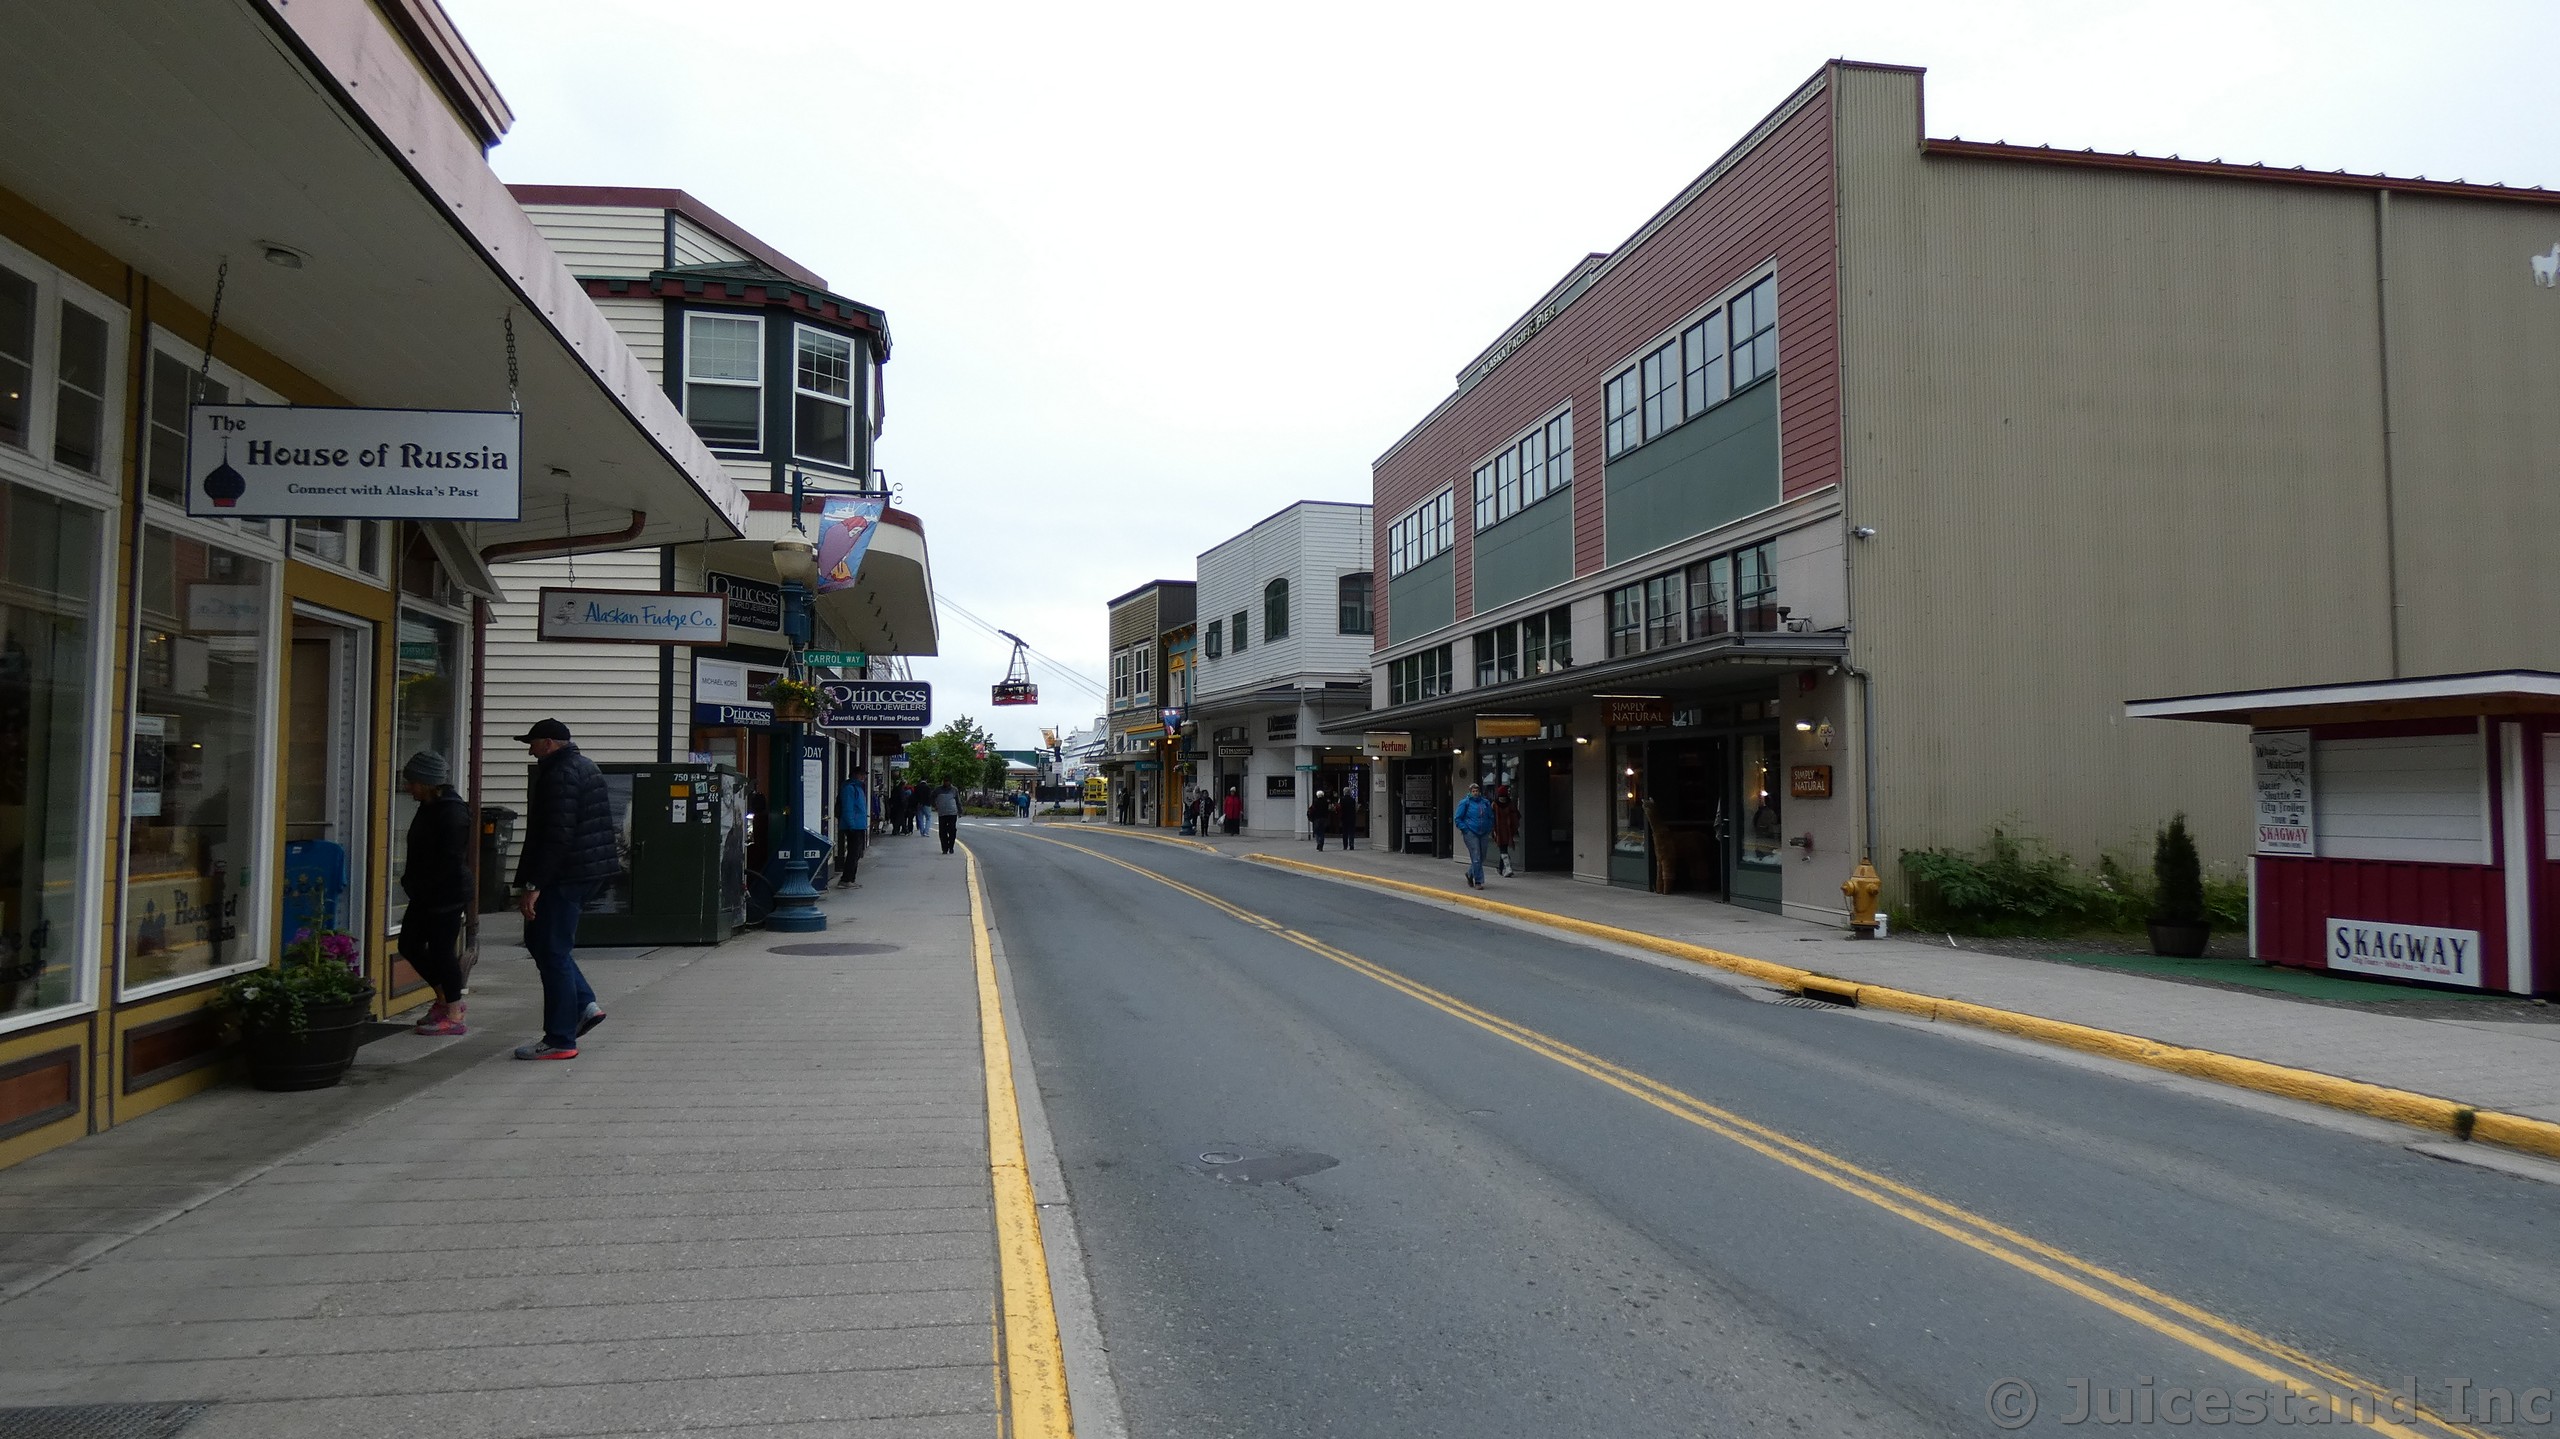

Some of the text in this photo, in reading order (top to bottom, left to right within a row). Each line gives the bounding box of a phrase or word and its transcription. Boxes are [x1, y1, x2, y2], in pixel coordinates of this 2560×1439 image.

[1481, 305, 1556, 377] ALASKA PACIFIC PIER
[209, 415, 246, 431] The
[247, 440, 508, 470] House of Russia
[288, 483, 479, 497] Connect with Alaska's Past
[711, 576, 778, 606] Princess
[750, 604, 779, 615] JEWELERS
[583, 602, 717, 630] Alaskan Fudge Co.
[808, 654, 861, 663] CARROL WAY
[702, 677, 738, 687] MICHAEL KORS
[851, 703, 927, 711] WORLD JEWELERS
[1612, 702, 1646, 711] SIMPLY
[719, 706, 771, 723] Princess
[1612, 712, 1664, 721] NATURAL
[1381, 741, 1407, 752] Perfume
[2265, 759, 2305, 773] Watching
[673, 773, 688, 781] 750
[1794, 769, 1815, 780] SIMPLY
[1794, 781, 1826, 791] NATURAL
[2264, 791, 2290, 801] Shuttle
[2261, 802, 2305, 815] City Trolley
[2259, 826, 2308, 844] SKAGWAY
[2336, 926, 2468, 974] SKAGWAY
